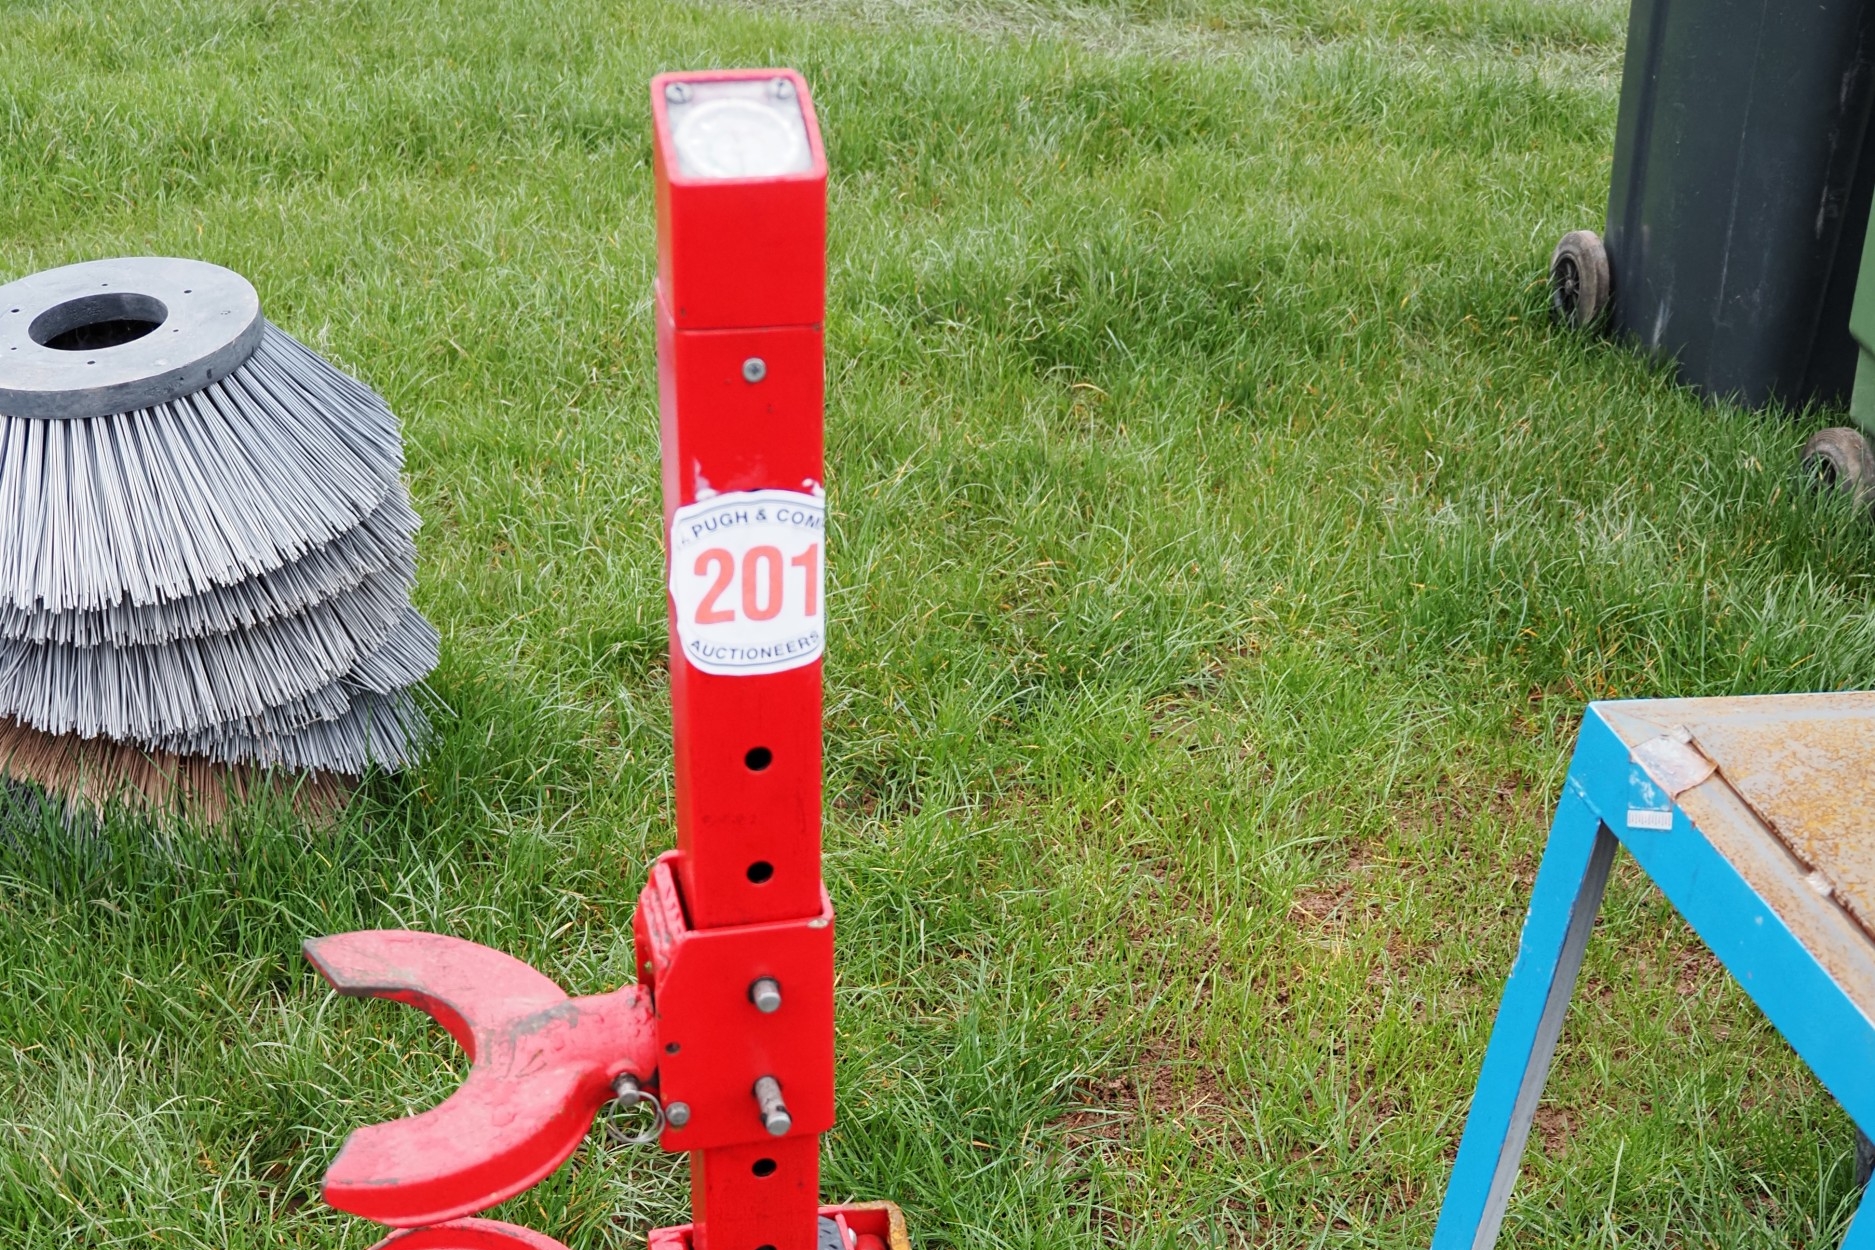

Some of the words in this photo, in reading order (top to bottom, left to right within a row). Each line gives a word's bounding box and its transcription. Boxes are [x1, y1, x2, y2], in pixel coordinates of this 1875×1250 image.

[692, 511, 748, 538] PUGH
[755, 508, 766, 521] &
[776, 508, 823, 529] COM
[694, 542, 818, 625] 201
[691, 630, 819, 661] AUCTIONEERS
